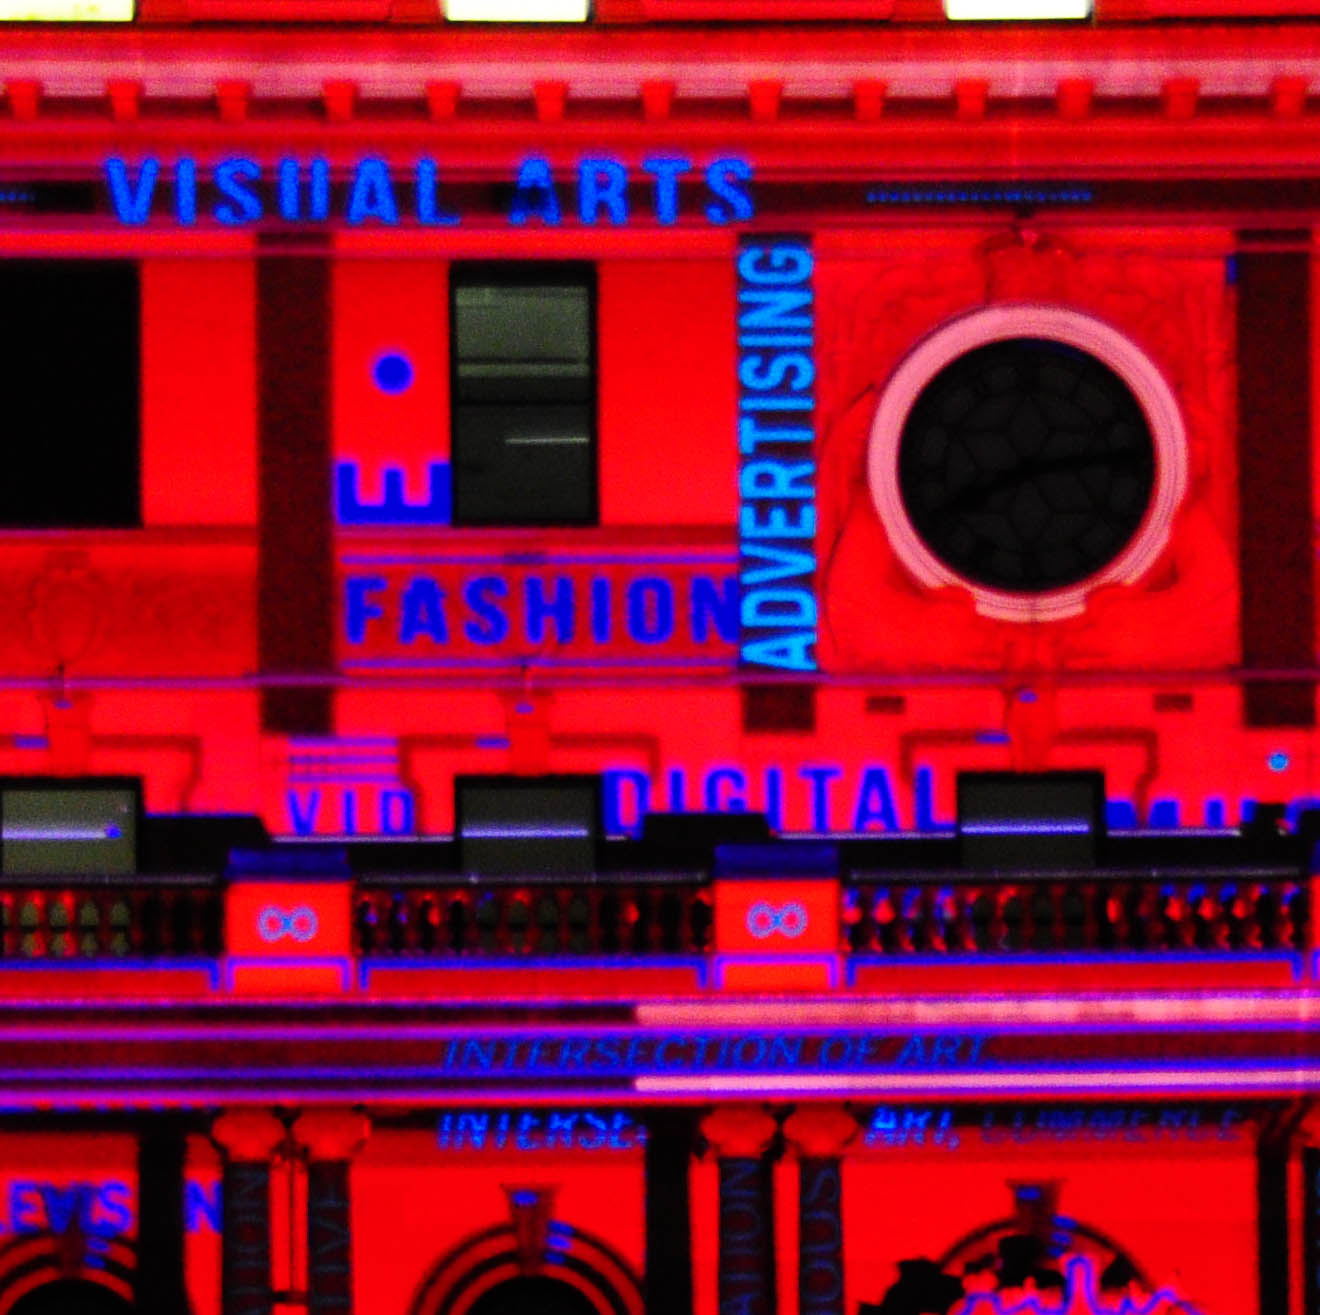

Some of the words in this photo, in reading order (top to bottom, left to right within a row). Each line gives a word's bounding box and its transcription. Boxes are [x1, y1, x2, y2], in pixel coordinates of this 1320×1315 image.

[104, 155, 460, 227] VISUAL
[508, 157, 756, 227] ARTS
[737, 243, 818, 672] ADVERTISING
[342, 573, 742, 648] FASHION
[602, 765, 955, 840] DIGITAL
